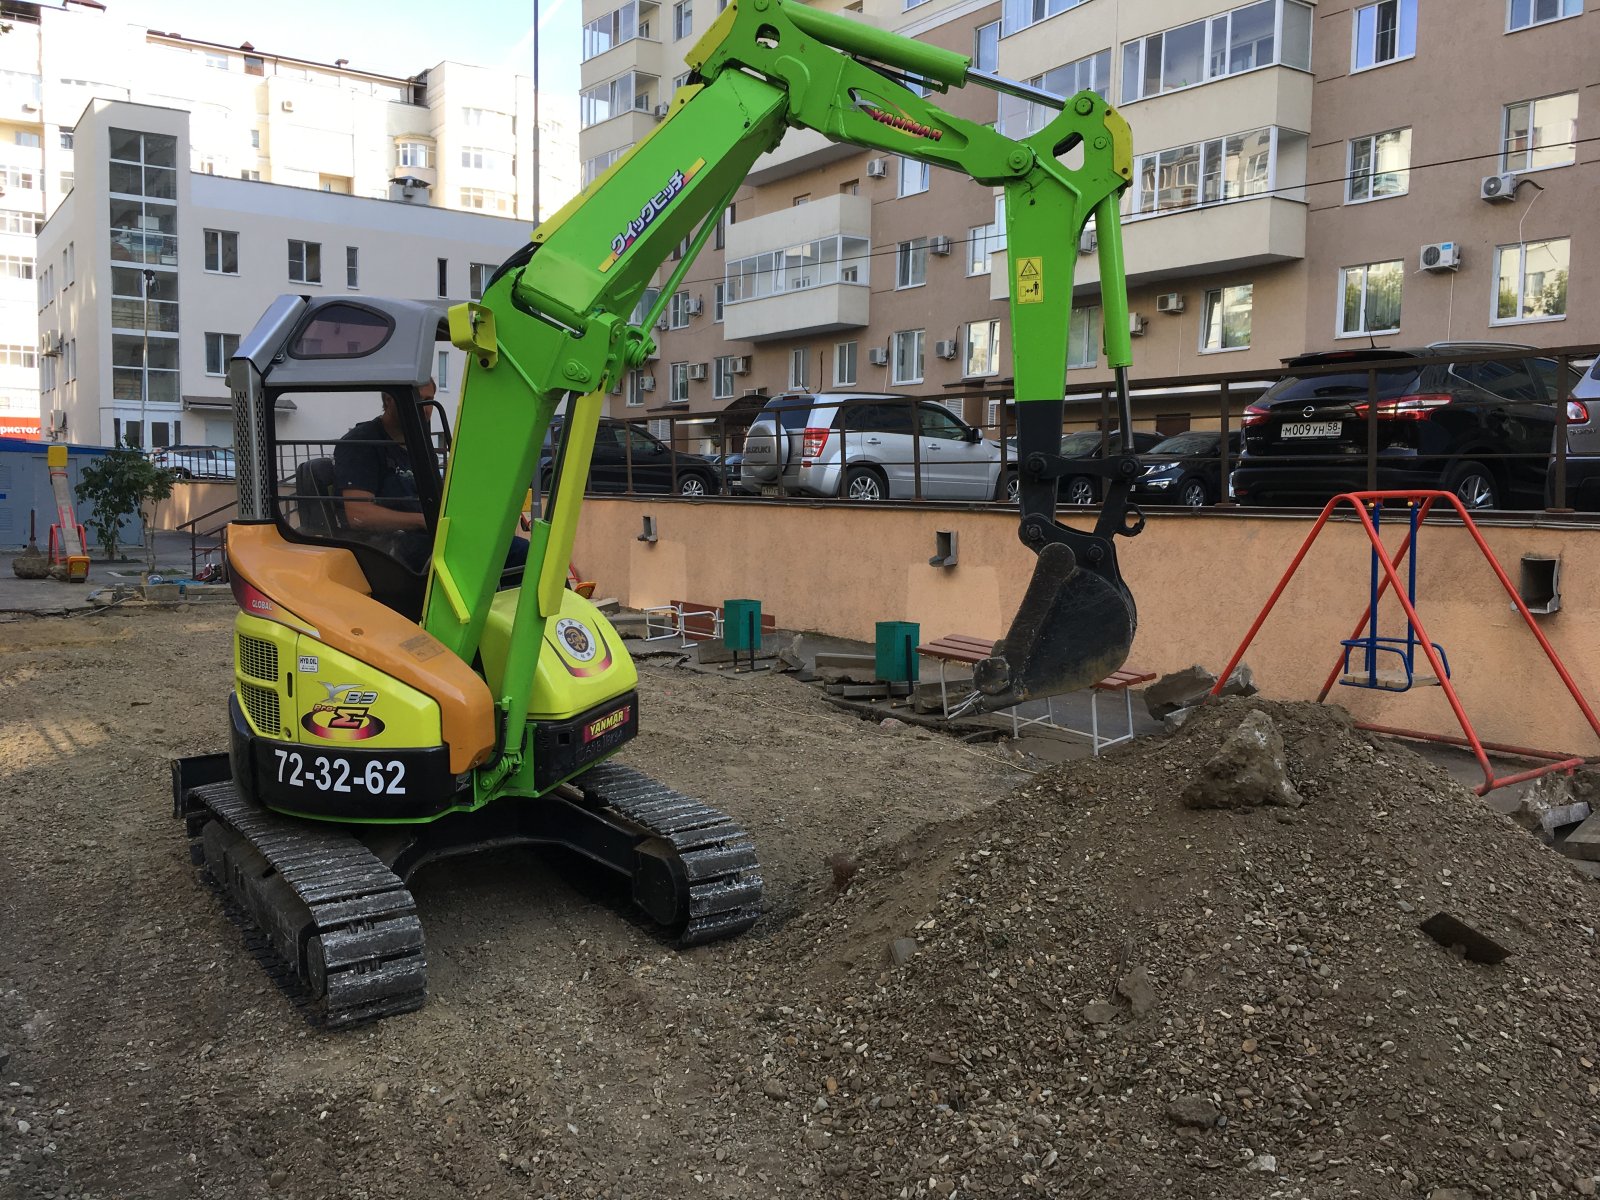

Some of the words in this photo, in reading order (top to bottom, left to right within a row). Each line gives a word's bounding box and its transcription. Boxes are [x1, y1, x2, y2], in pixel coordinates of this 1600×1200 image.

[872, 108, 943, 142] YANMAR
[610, 169, 685, 255] クイックヒッチ
[1327, 422, 1338, 431] 58
[746, 445, 771, 454] SUZUKI
[251, 599, 273, 611] GLOBAL
[589, 710, 625, 736] YANMAR
[274, 748, 406, 796] 72-32-62
